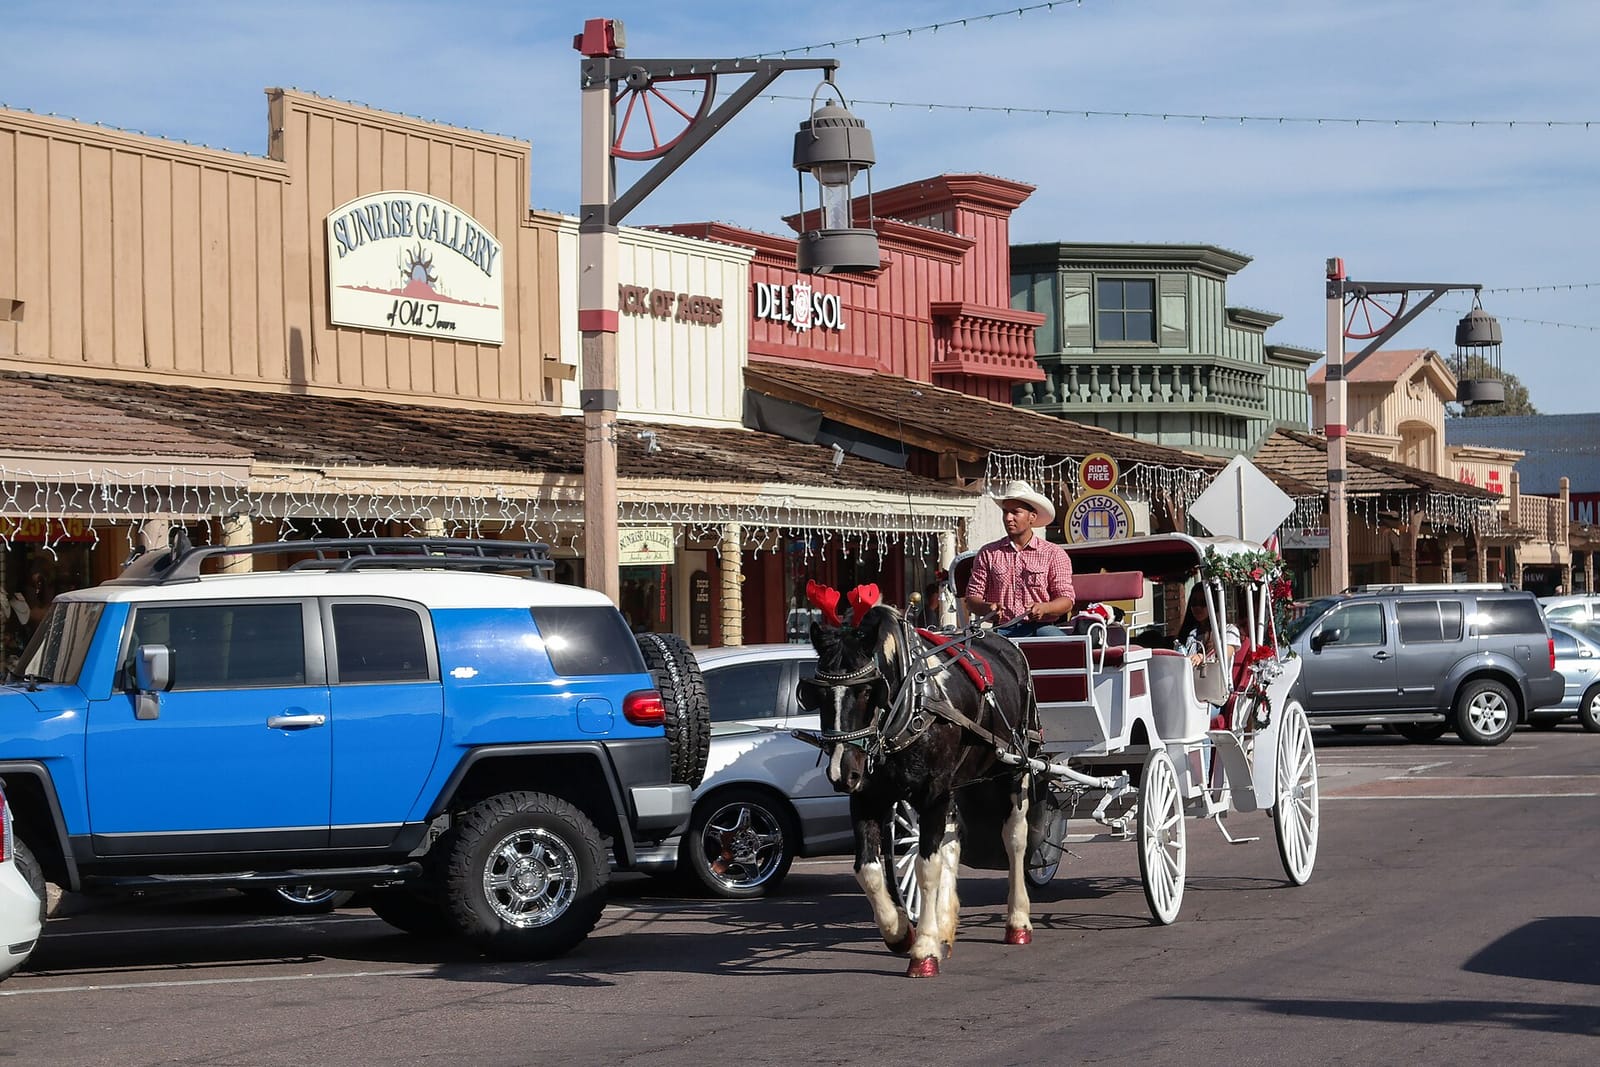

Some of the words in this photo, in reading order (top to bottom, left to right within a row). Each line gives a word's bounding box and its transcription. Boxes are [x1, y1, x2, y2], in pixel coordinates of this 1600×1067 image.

[333, 199, 413, 259] SUNRISE
[415, 202, 500, 278] GALLERY
[387, 299, 399, 327] of
[399, 300, 424, 326] Old
[425, 303, 456, 330] Town
[650, 288, 676, 319] OF
[676, 293, 723, 326] AGES
[757, 282, 792, 322] DEL
[813, 291, 846, 330] SOL
[1087, 473, 1110, 481] FREE
[1088, 464, 1109, 473] RIDE
[1072, 497, 1127, 528] SCOTTSDALE
